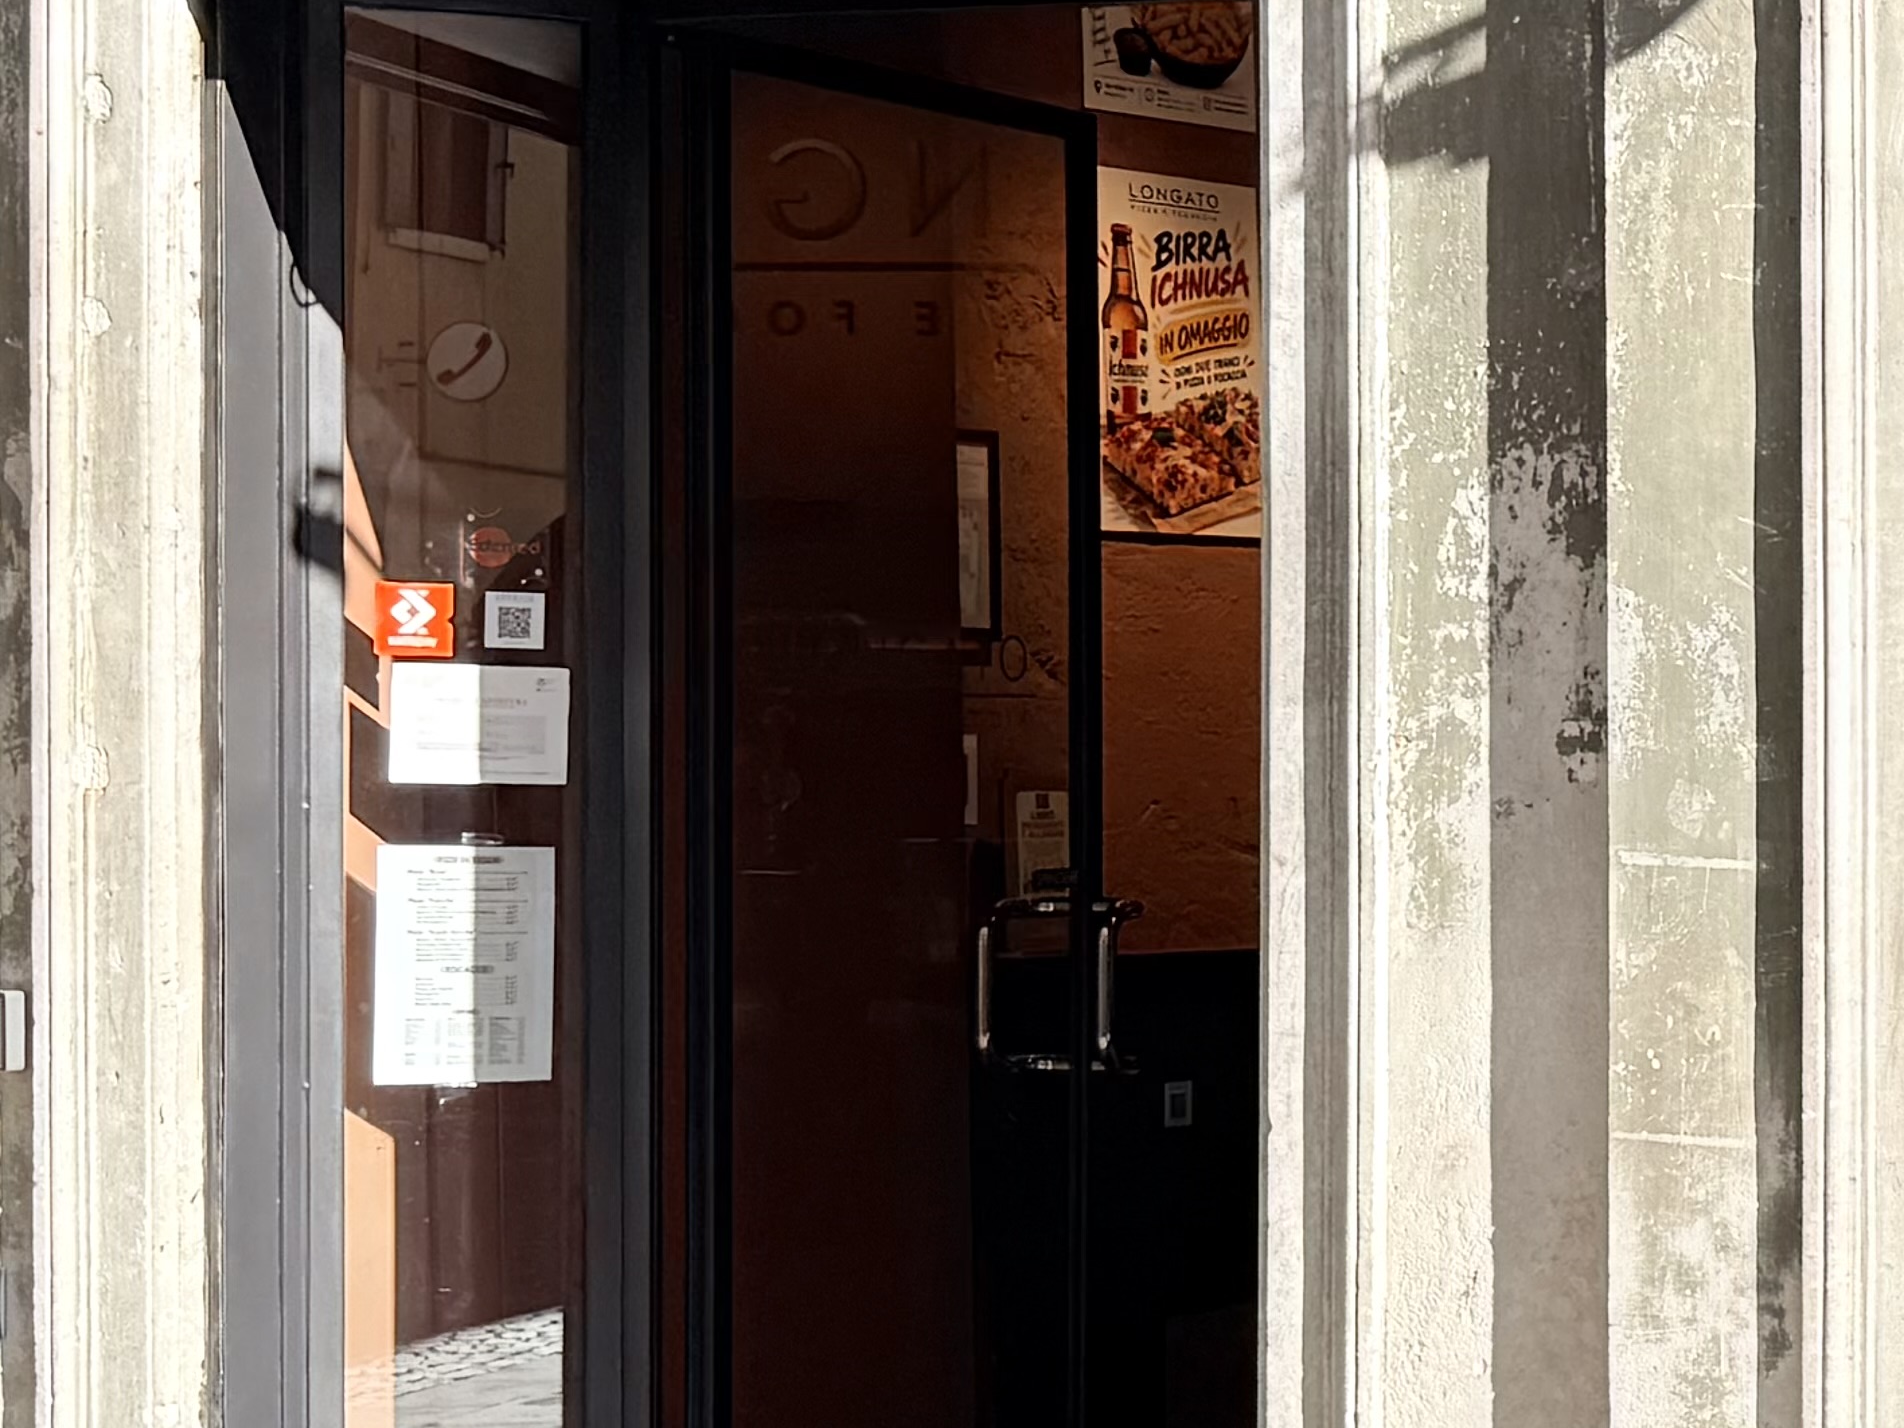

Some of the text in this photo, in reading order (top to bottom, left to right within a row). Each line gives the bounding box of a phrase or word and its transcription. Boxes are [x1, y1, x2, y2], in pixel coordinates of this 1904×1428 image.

[1128, 182, 1220, 209] LONGATO
[1154, 228, 1232, 270] BIRRA
[1150, 258, 1250, 310] ICHNUSA
[1159, 312, 1250, 356] IN OMAGGIO
